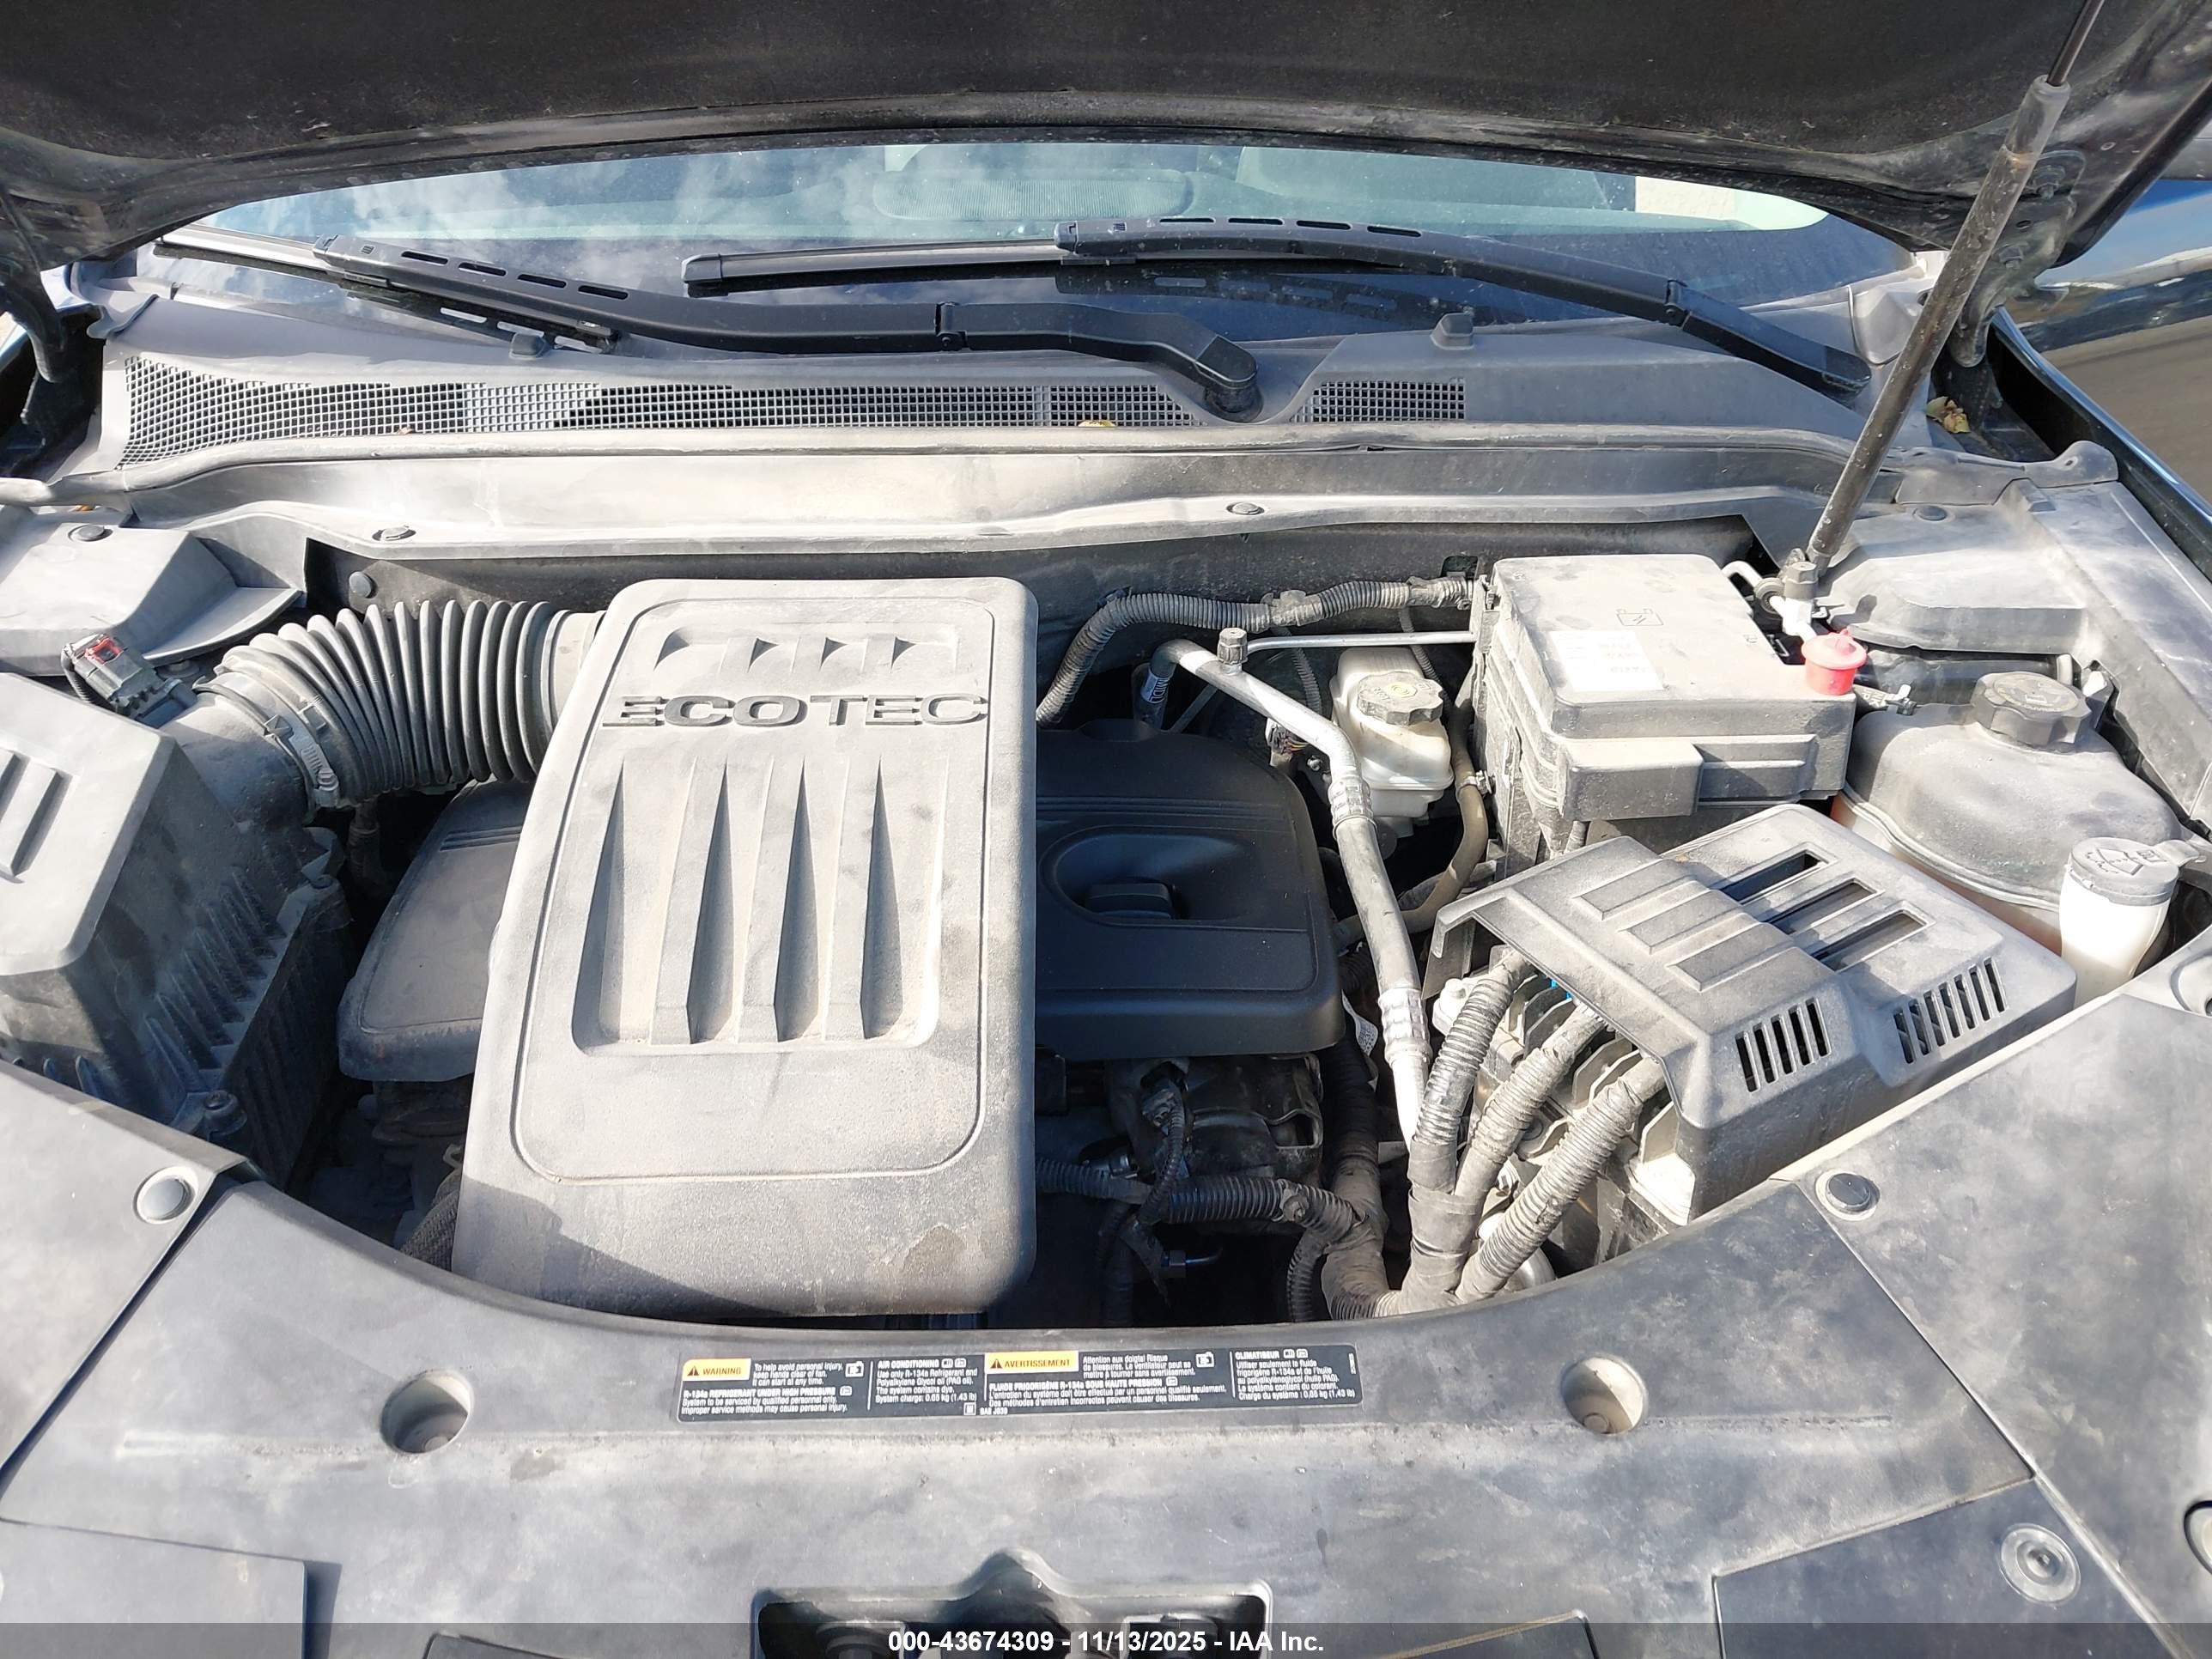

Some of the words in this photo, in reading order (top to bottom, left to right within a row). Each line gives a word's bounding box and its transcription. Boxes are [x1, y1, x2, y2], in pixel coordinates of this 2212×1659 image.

[602, 694, 988, 727] ECOTEC
[1083, 1355, 1111, 1364] Attention
[1147, 1353, 1168, 1363] Risque
[1235, 1350, 1280, 1360] CLIMATISEUR
[763, 1364, 777, 1372] help
[778, 1363, 795, 1371] avoid
[796, 1362, 823, 1371] personal
[878, 1360, 890, 1369] AIR
[891, 1358, 939, 1369] CONDITIONING
[1005, 1359, 1070, 1368] AVERTISSEMENT
[1236, 1361, 1257, 1370] Utiliser
[1259, 1360, 1291, 1369] seulement
[1299, 1358, 1317, 1368] fluide
[890, 1370, 904, 1378] only
[905, 1369, 928, 1377] R-134a
[929, 1369, 965, 1377] Refrigerant
[966, 1368, 978, 1376] and
[1084, 1370, 1104, 1379] mettre
[1271, 1367, 1296, 1376] R-134a
[877, 1377, 915, 1387] Polyalkylene
[917, 1377, 936, 1386] Glycol
[946, 1376, 961, 1386] (PAG
[989, 1382, 1012, 1391] FLUIDE
[1060, 1381, 1084, 1389] R-134a
[1085, 1380, 1104, 1389] SOUS
[1105, 1379, 1127, 1388] HAUTE
[1128, 1378, 1162, 1388] PRESSION
[1274, 1382, 1301, 1392] contient
[1302, 1382, 1310, 1391] du
[684, 1389, 708, 1398] R-134a
[709, 1389, 757, 1398] REFRIGERANT
[757, 1388, 781, 1397] UNDER
[781, 1388, 799, 1396] HIGH
[800, 1387, 836, 1396] PRESSURE
[876, 1386, 889, 1395] The
[890, 1386, 913, 1395] system
[1060, 1389, 1073, 1398] doit
[1115, 1389, 1126, 1397] par
[1136, 1387, 1167, 1395] personnel
[1238, 1392, 1261, 1402] Charge
[1319, 1389, 1328, 1400] kg
[1346, 1389, 1356, 1398] lb)
[683, 1399, 706, 1407] System
[753, 1398, 761, 1407] by
[763, 1397, 789, 1406] qualified
[791, 1396, 822, 1405] personnel
[876, 1395, 899, 1404] System
[900, 1395, 925, 1403] charge:
[926, 1394, 940, 1402] 0.65
[941, 1393, 950, 1403] kg
[951, 1393, 968, 1402] (1.43
[969, 1392, 977, 1402] lb)
[1071, 1396, 1105, 1405] incorrectes
[1106, 1396, 1132, 1406] peuvent
[682, 1407, 710, 1415] Improper
[764, 1405, 778, 1414] may
[799, 1404, 828, 1413] personal
